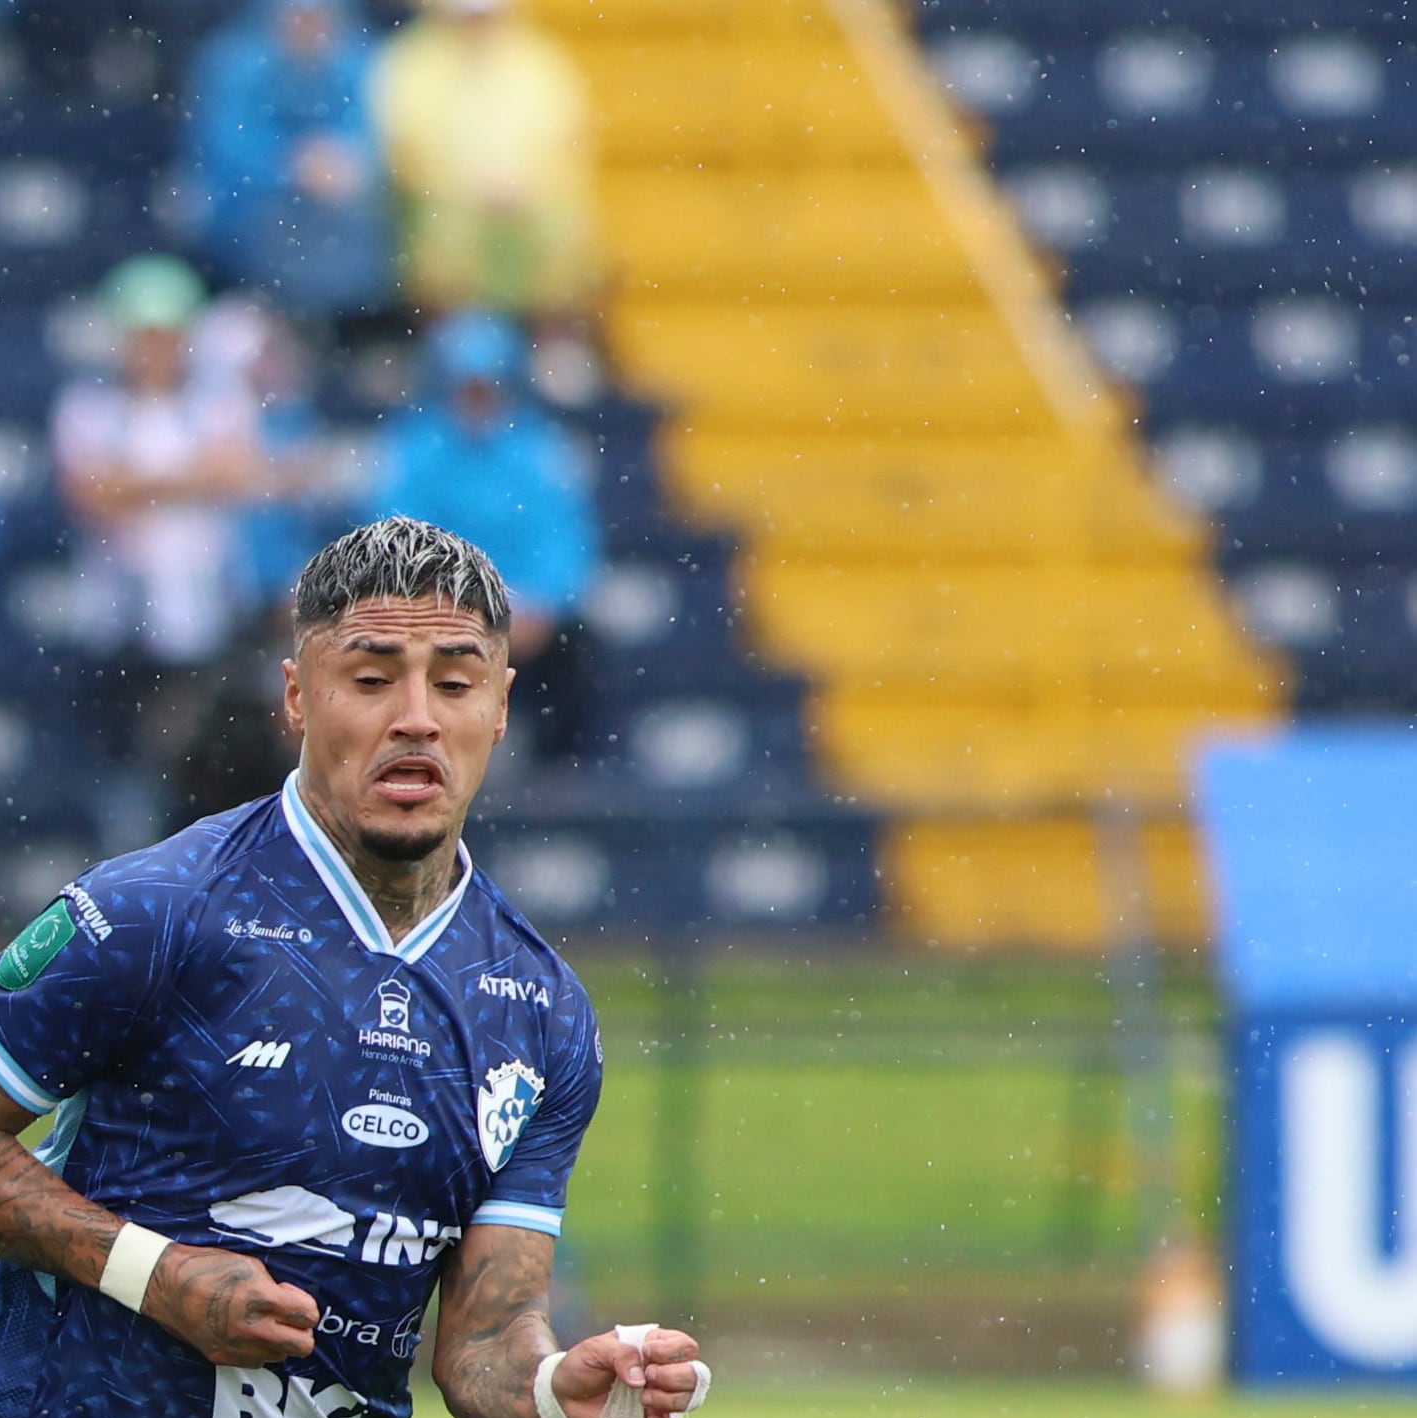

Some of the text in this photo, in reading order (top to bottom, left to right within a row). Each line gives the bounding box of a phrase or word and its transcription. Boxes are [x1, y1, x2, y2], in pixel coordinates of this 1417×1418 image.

[246, 919, 295, 939] Familia
[358, 1029, 431, 1058] HARIANA
[368, 1087, 413, 1108] Pinturas
[348, 1112, 421, 1142] CELCO
